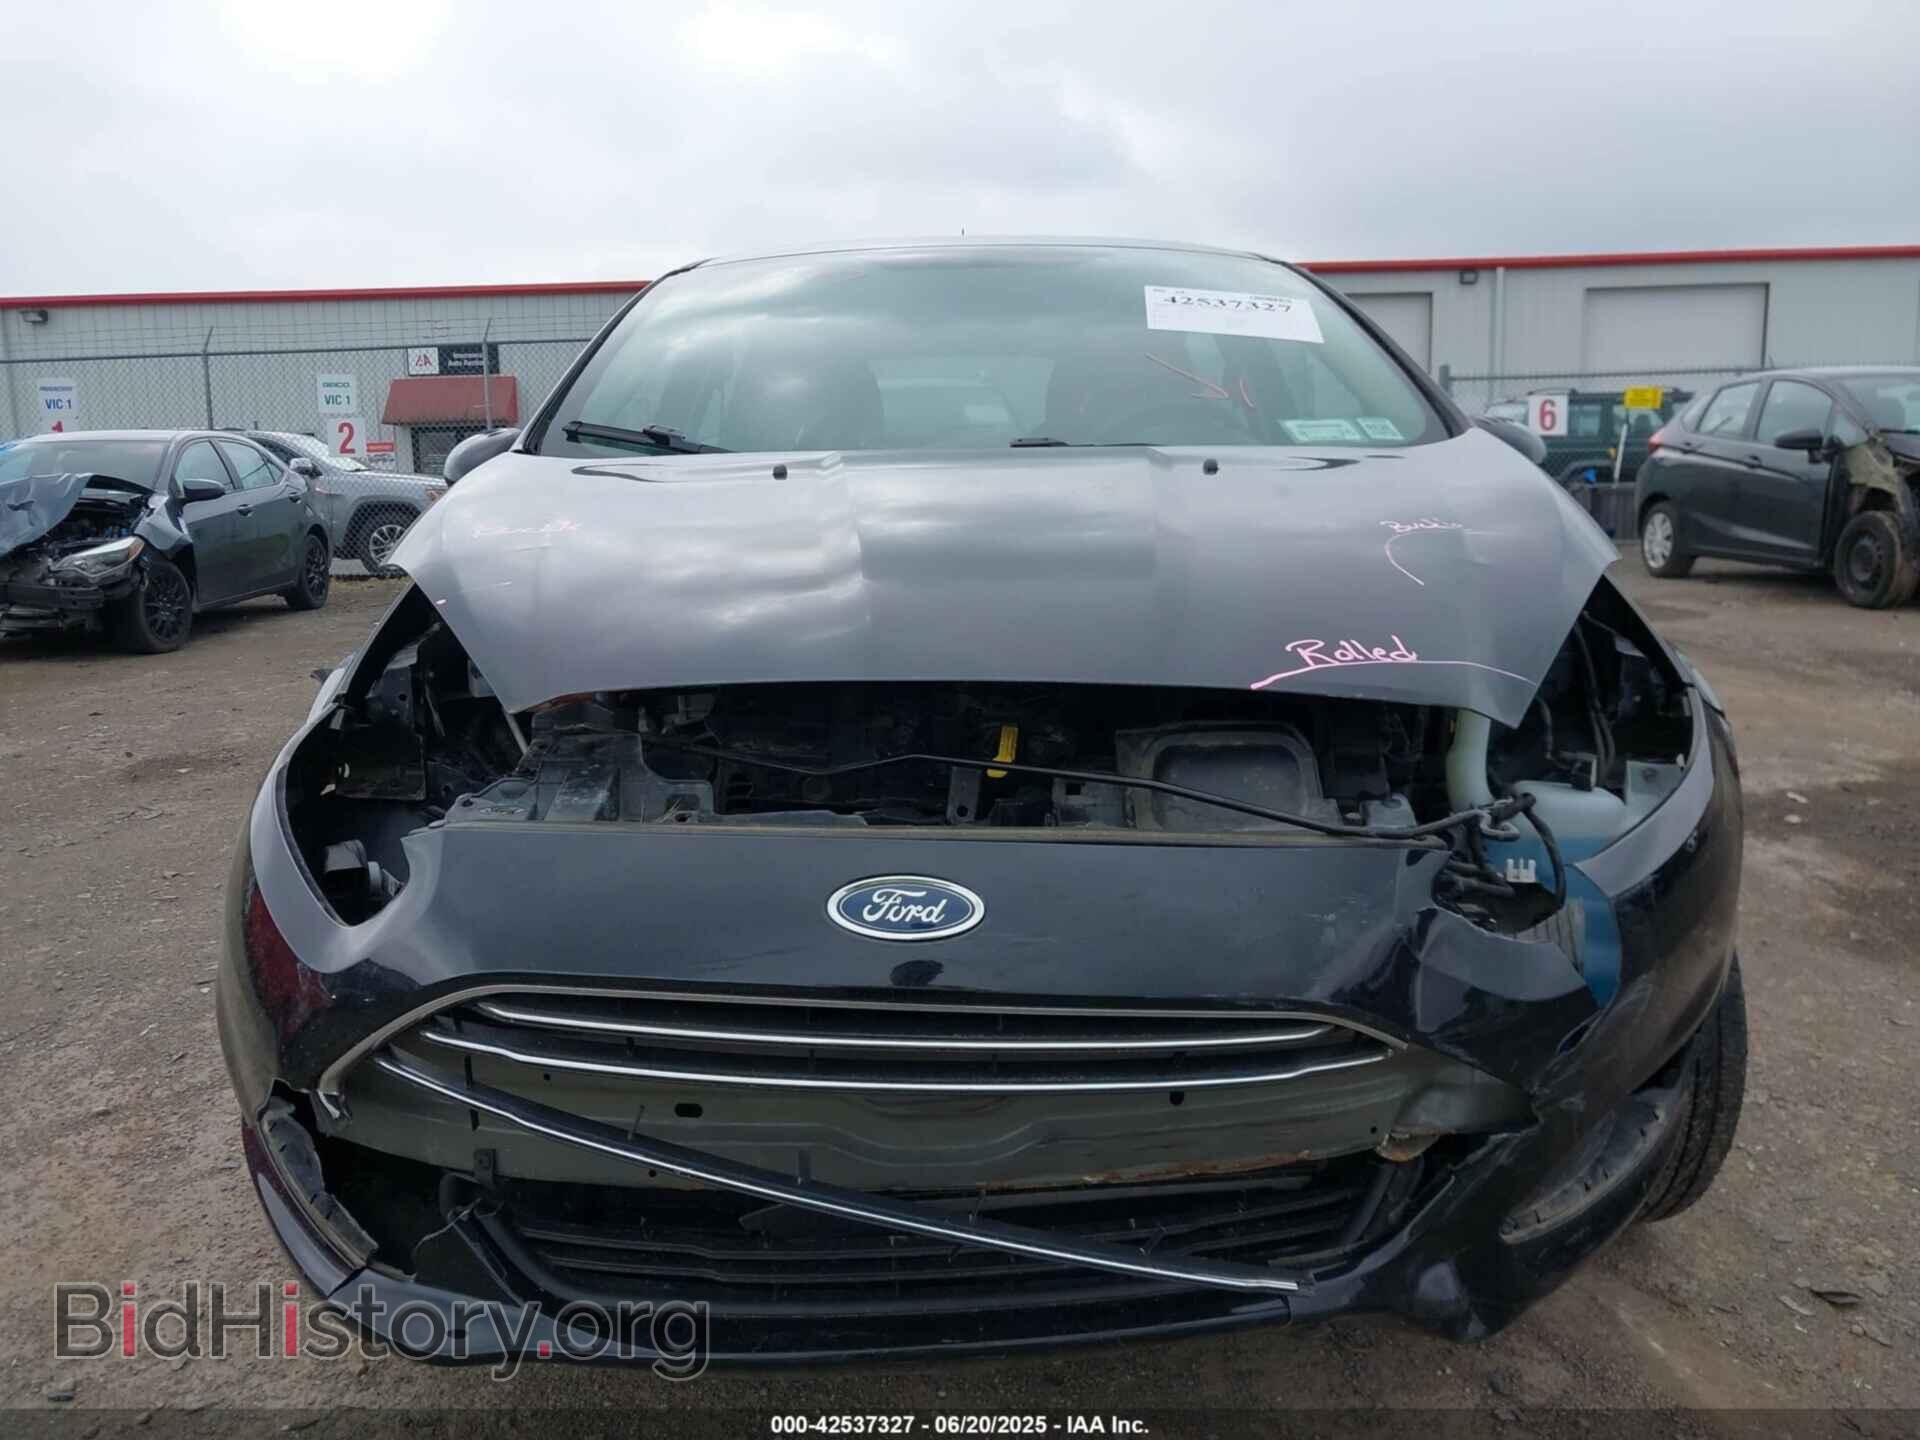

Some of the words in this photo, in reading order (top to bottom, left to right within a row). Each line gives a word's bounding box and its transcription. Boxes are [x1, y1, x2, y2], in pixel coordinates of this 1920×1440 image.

[1163, 296, 1291, 312] 42537327
[45, 399, 64, 409] VIC
[67, 399, 72, 409] 1
[324, 395, 342, 405] VIC
[346, 395, 351, 405] 1
[1540, 399, 1556, 430] 6
[338, 422, 355, 454] 2
[1285, 635, 1417, 666] Rolled
[862, 888, 948, 923] Ford
